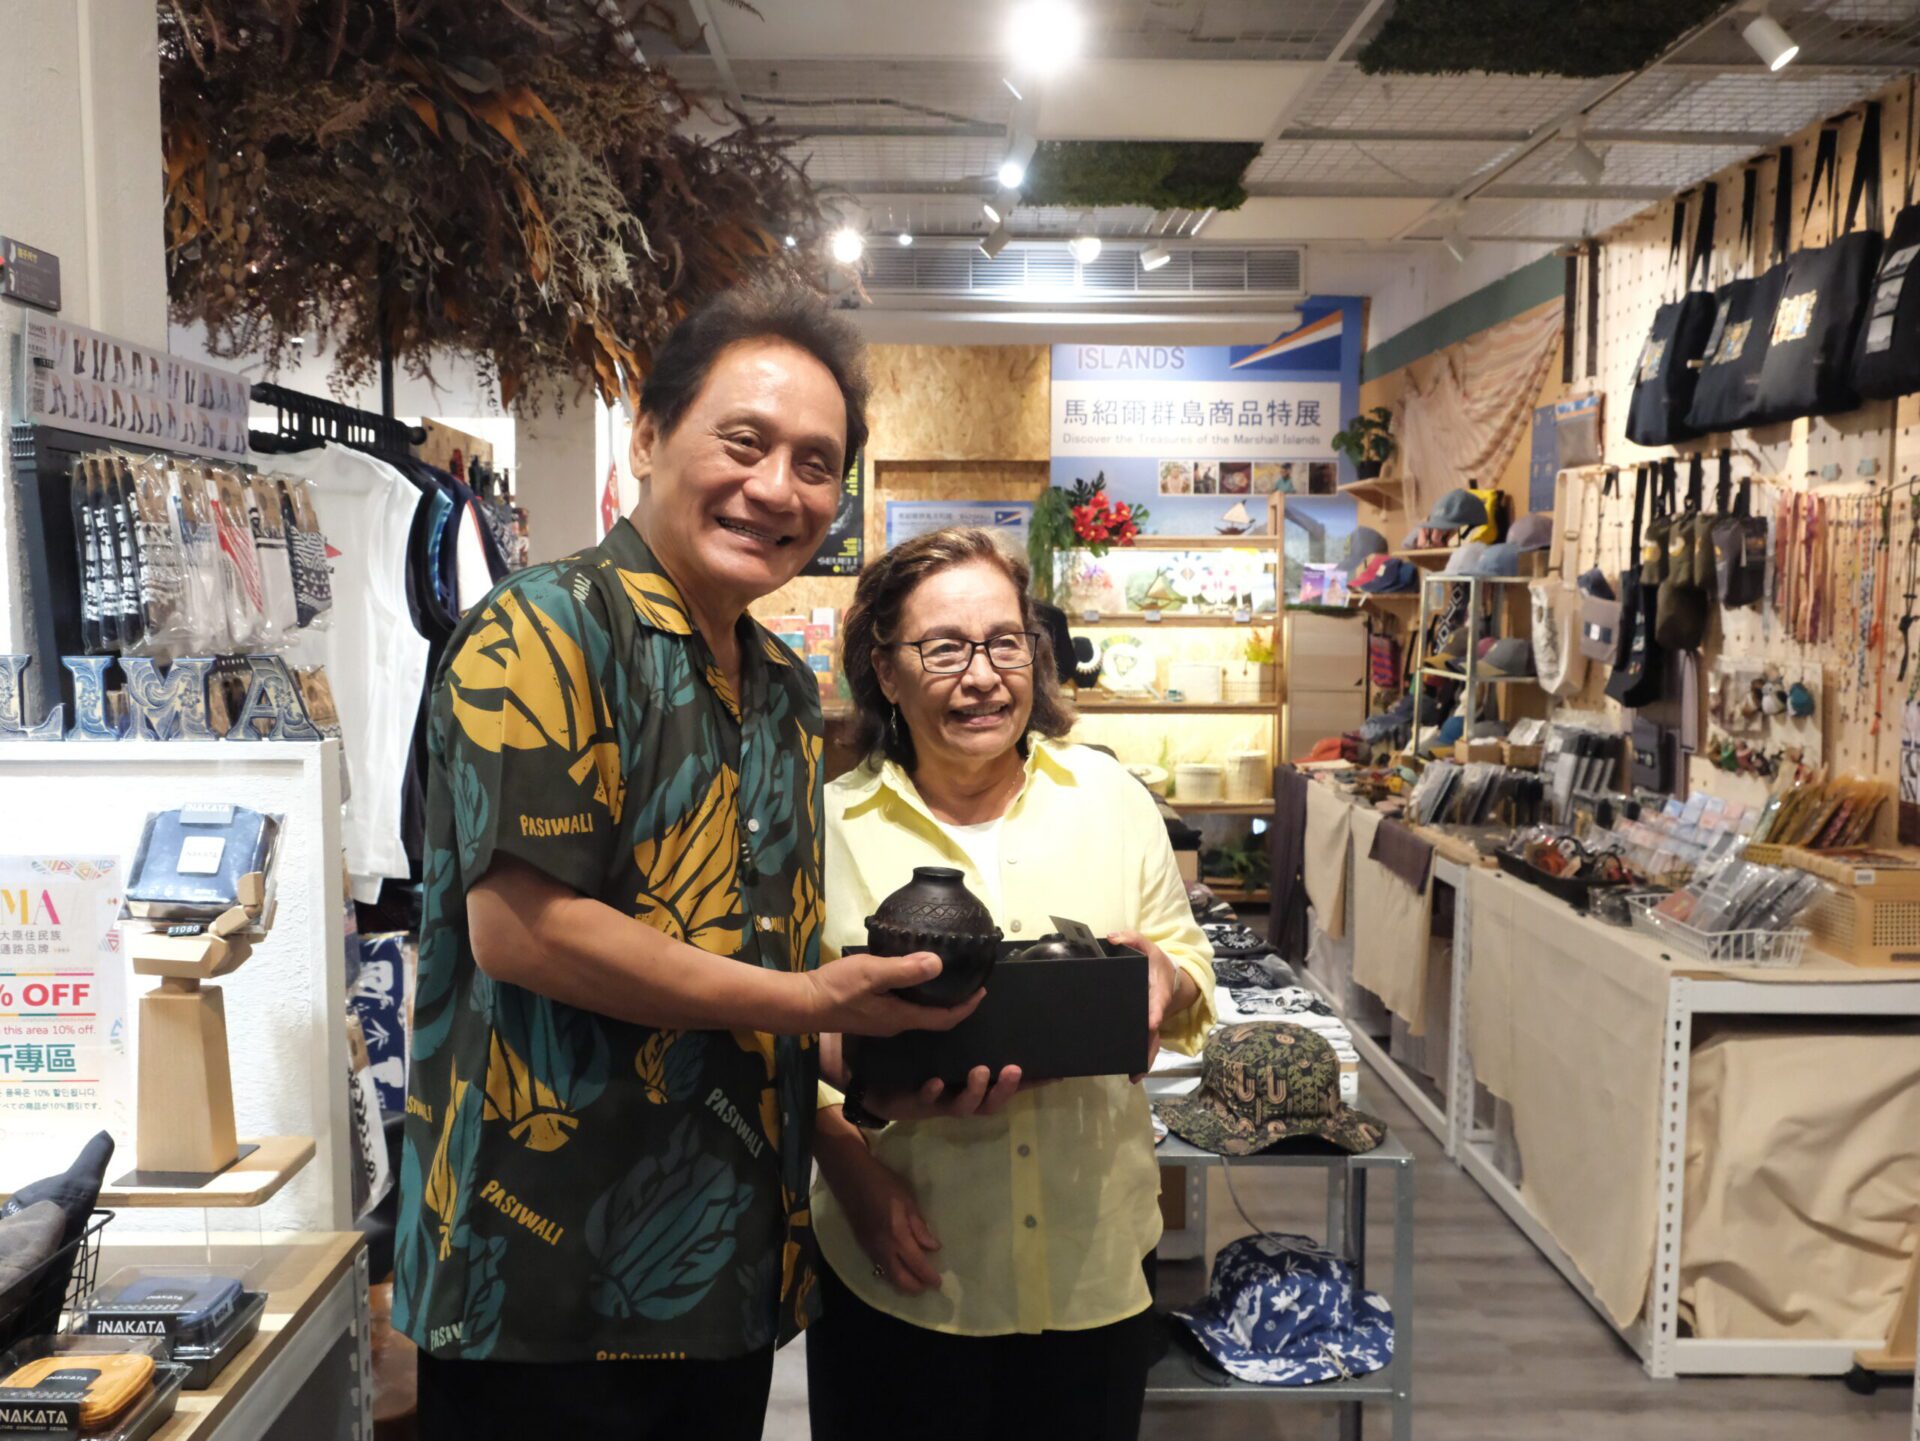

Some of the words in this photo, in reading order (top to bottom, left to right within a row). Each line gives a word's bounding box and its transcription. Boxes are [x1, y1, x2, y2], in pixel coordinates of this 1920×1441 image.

[1077, 347, 1185, 370] ISLANDS
[1063, 399, 1322, 427] 馬紹爾群島商品特展
[1063, 433, 1111, 444] Discover
[1115, 433, 1133, 444] the
[1139, 434, 1193, 444] Treasures
[1197, 433, 1208, 444] of
[1212, 434, 1231, 445] the
[1233, 434, 1280, 445] Marshall
[1283, 434, 1321, 445] Islands
[520, 812, 594, 837] PASIWALI
[22, 983, 91, 1006] OFF
[4, 1025, 23, 1035] this
[26, 1026, 49, 1035] area
[53, 1025, 75, 1035] 10%
[704, 1088, 764, 1159] PASIWALI
[480, 1180, 564, 1245] PASIWALI
[97, 1320, 166, 1334] iNAKATA
